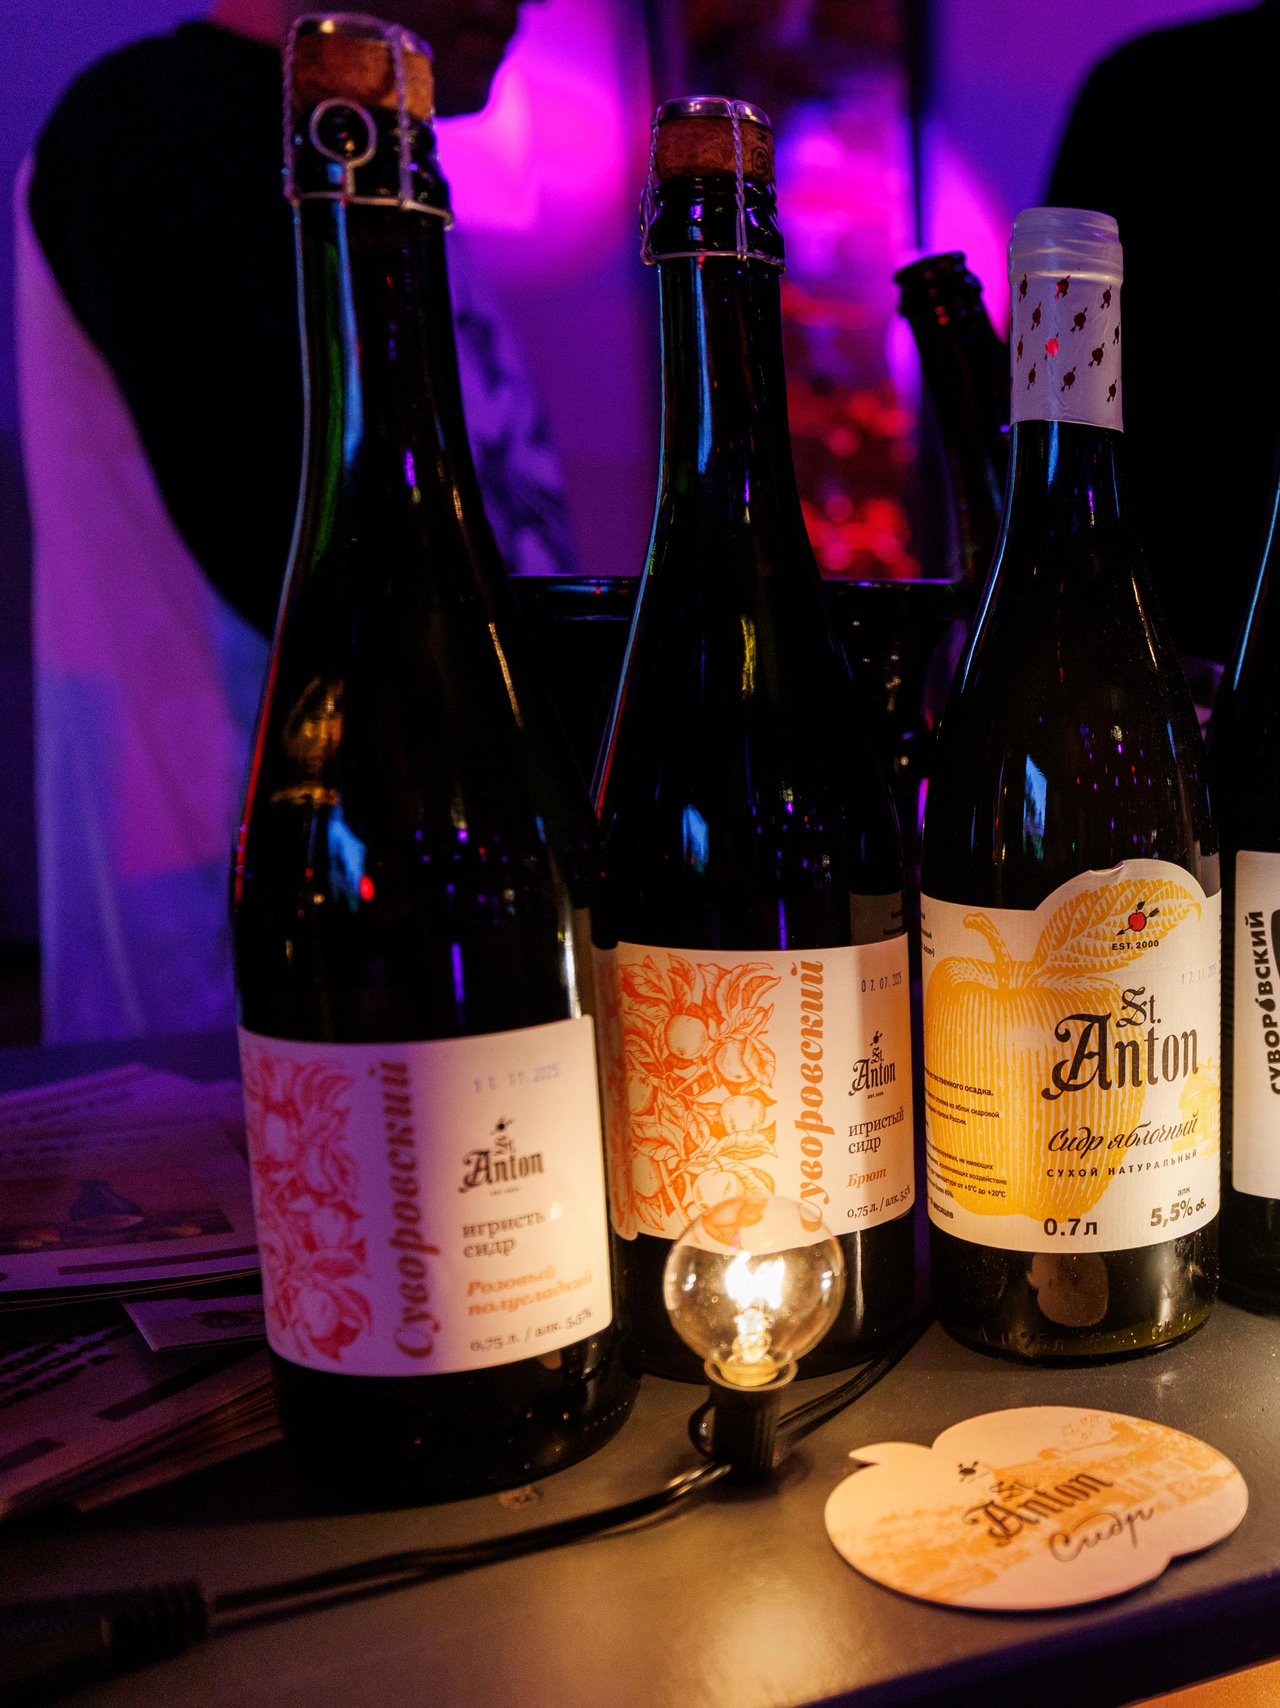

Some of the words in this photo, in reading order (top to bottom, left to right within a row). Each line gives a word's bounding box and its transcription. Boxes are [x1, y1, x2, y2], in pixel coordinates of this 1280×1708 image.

[1112, 942, 1133, 950] EST.
[1136, 939, 1159, 949] 2000
[1116, 986, 1162, 1028] St.
[1041, 1012, 1199, 1100] Anton
[848, 1058, 896, 1097] Anton
[964, 1085, 994, 1097] осадка.
[790, 960, 834, 1233] Суворовский
[849, 1105, 905, 1137] игристый
[971, 1108, 1000, 1119] сидровой
[848, 1136, 881, 1154] сидр
[1048, 1126, 1105, 1160] Сидр
[1107, 1110, 1200, 1150] яблочный
[458, 1149, 544, 1193] Anton
[846, 1168, 887, 1188] Брют
[1046, 1167, 1098, 1178] СУХОЙ
[1108, 1148, 1198, 1175] НАТУРАЛЬНЫЙ
[969, 1174, 1008, 1186] воздействие
[368, 1060, 442, 1360] Суворовский
[847, 1206, 869, 1219] 0,75
[869, 1203, 878, 1213] л.
[1150, 1198, 1193, 1228] 5,5%
[1195, 1197, 1207, 1212] об.
[463, 1239, 517, 1259] сидр
[961, 1472, 1114, 1548] Anton
